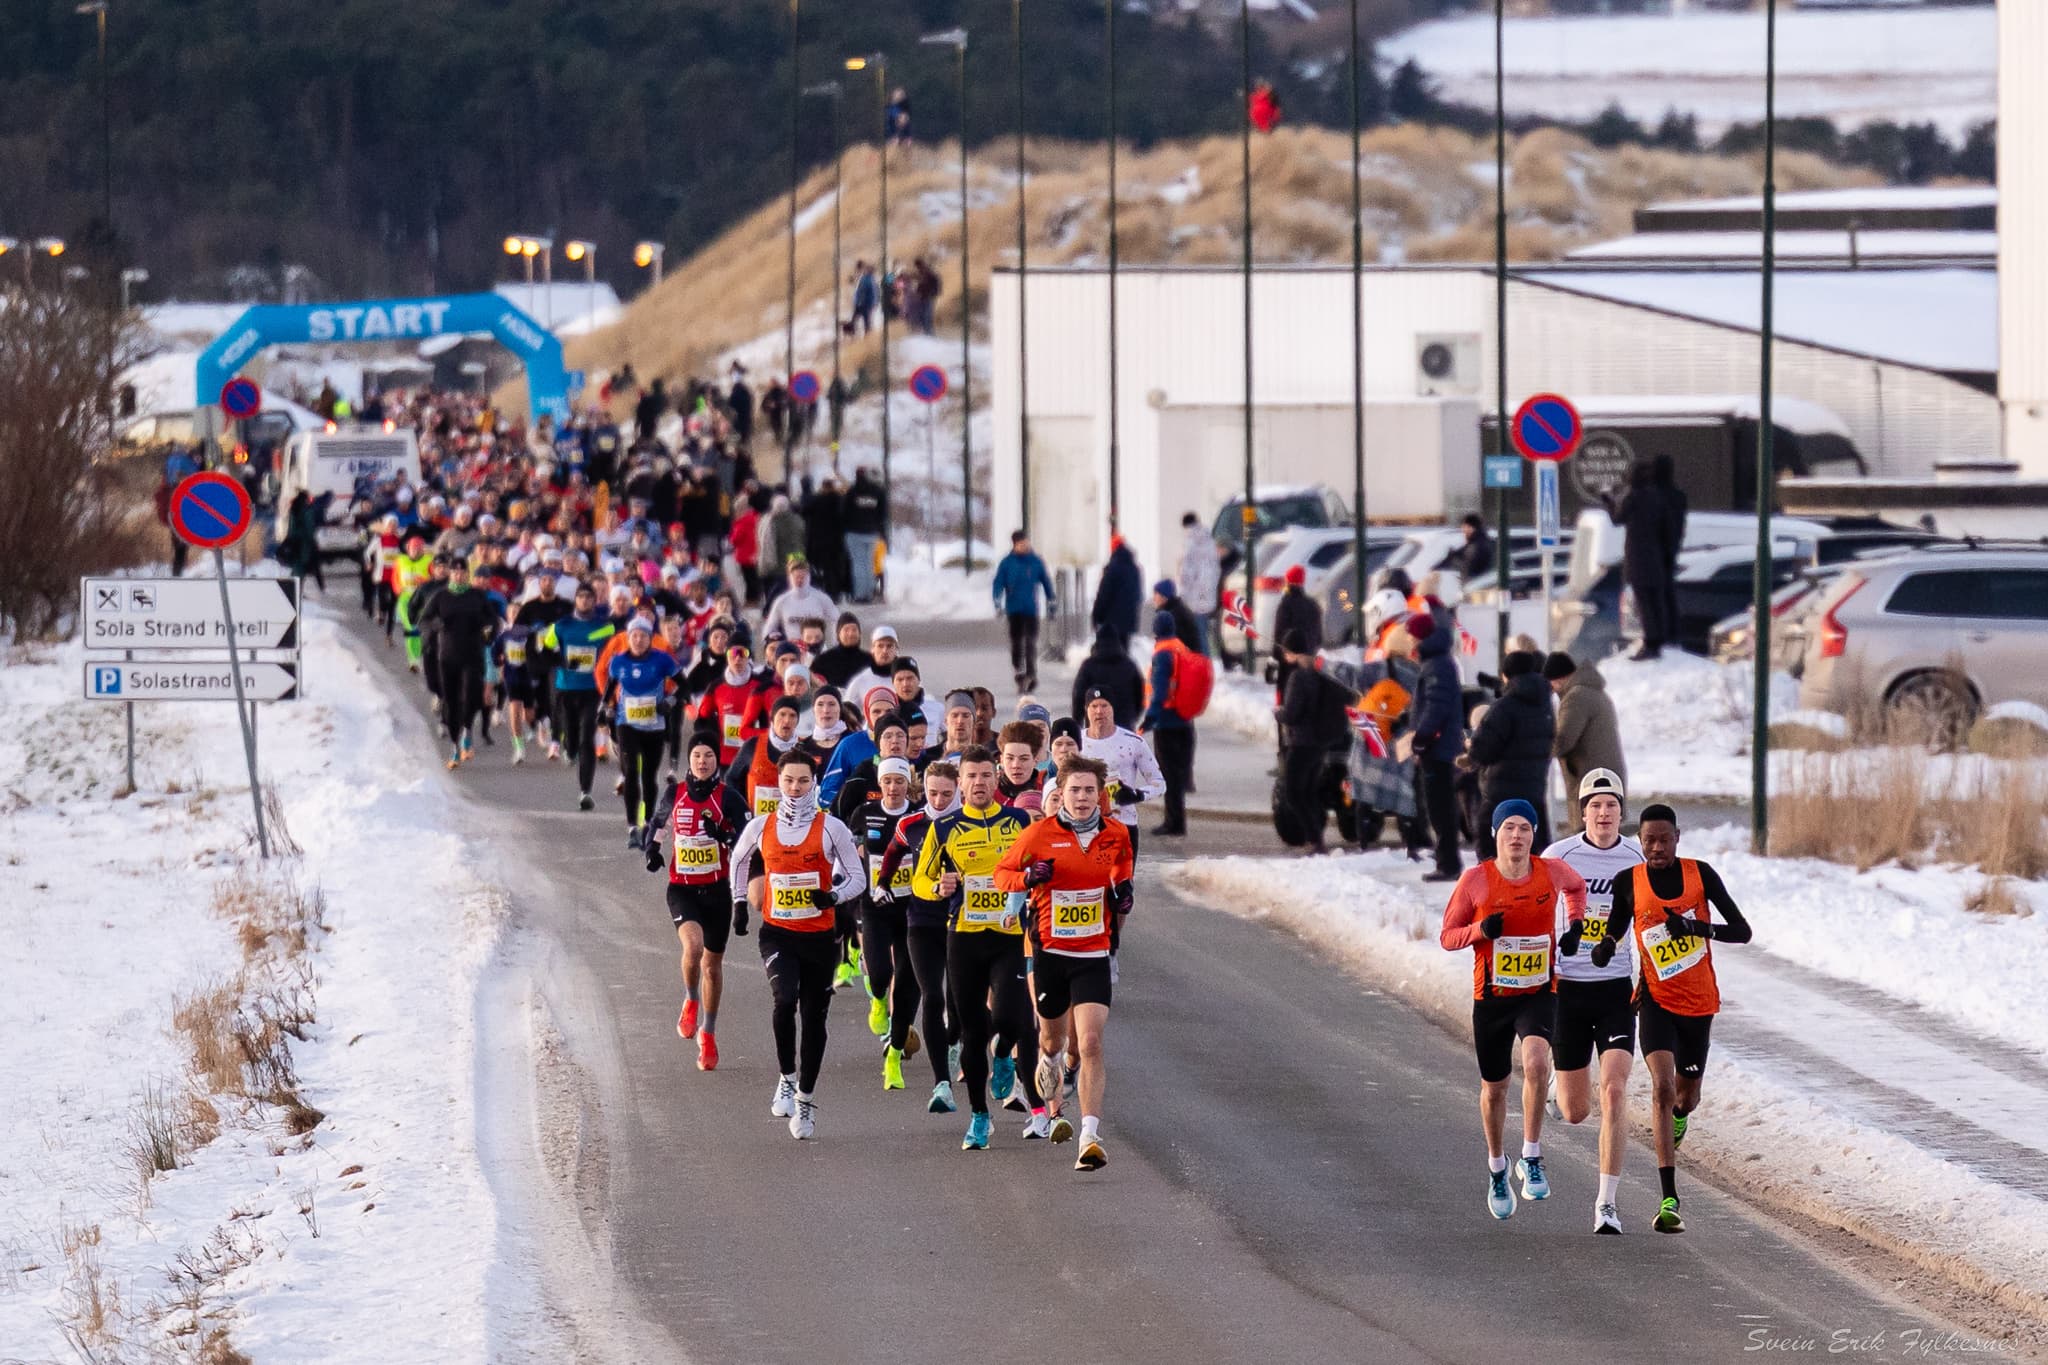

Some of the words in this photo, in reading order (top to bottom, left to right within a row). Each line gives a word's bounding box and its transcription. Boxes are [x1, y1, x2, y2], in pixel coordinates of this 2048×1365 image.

[308, 302, 450, 340] START
[95, 620, 135, 637] Sola
[144, 620, 206, 637] Strand
[215, 620, 269, 637] htell
[130, 671, 255, 690] Solastrandn
[681, 848, 713, 864] 2005
[777, 889, 813, 906] 2549
[971, 892, 1009, 908] 2838
[1060, 905, 1097, 923] 2061
[1502, 953, 1543, 973] 2144
